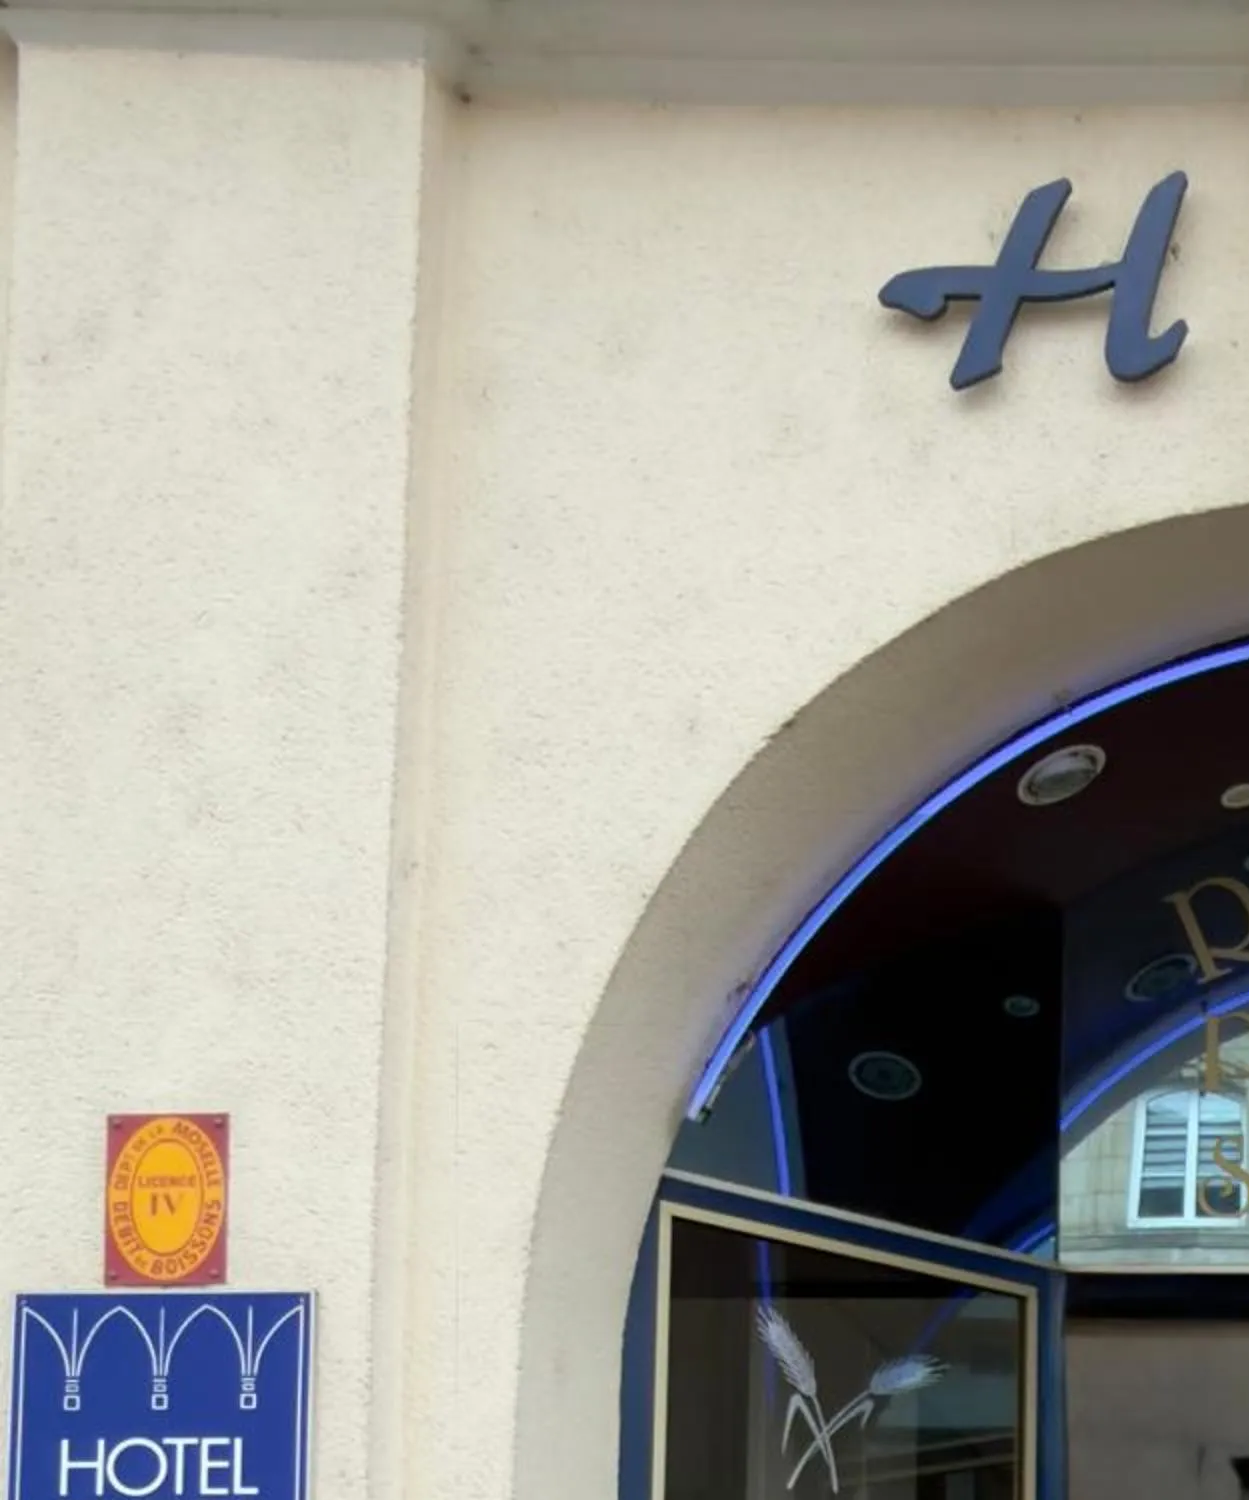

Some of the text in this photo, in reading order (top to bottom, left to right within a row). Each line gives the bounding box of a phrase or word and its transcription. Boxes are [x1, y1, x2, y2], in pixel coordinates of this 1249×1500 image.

[878, 170, 1189, 391] H
[150, 1191, 185, 1217] IV
[58, 1436, 260, 1498] HOTEL
